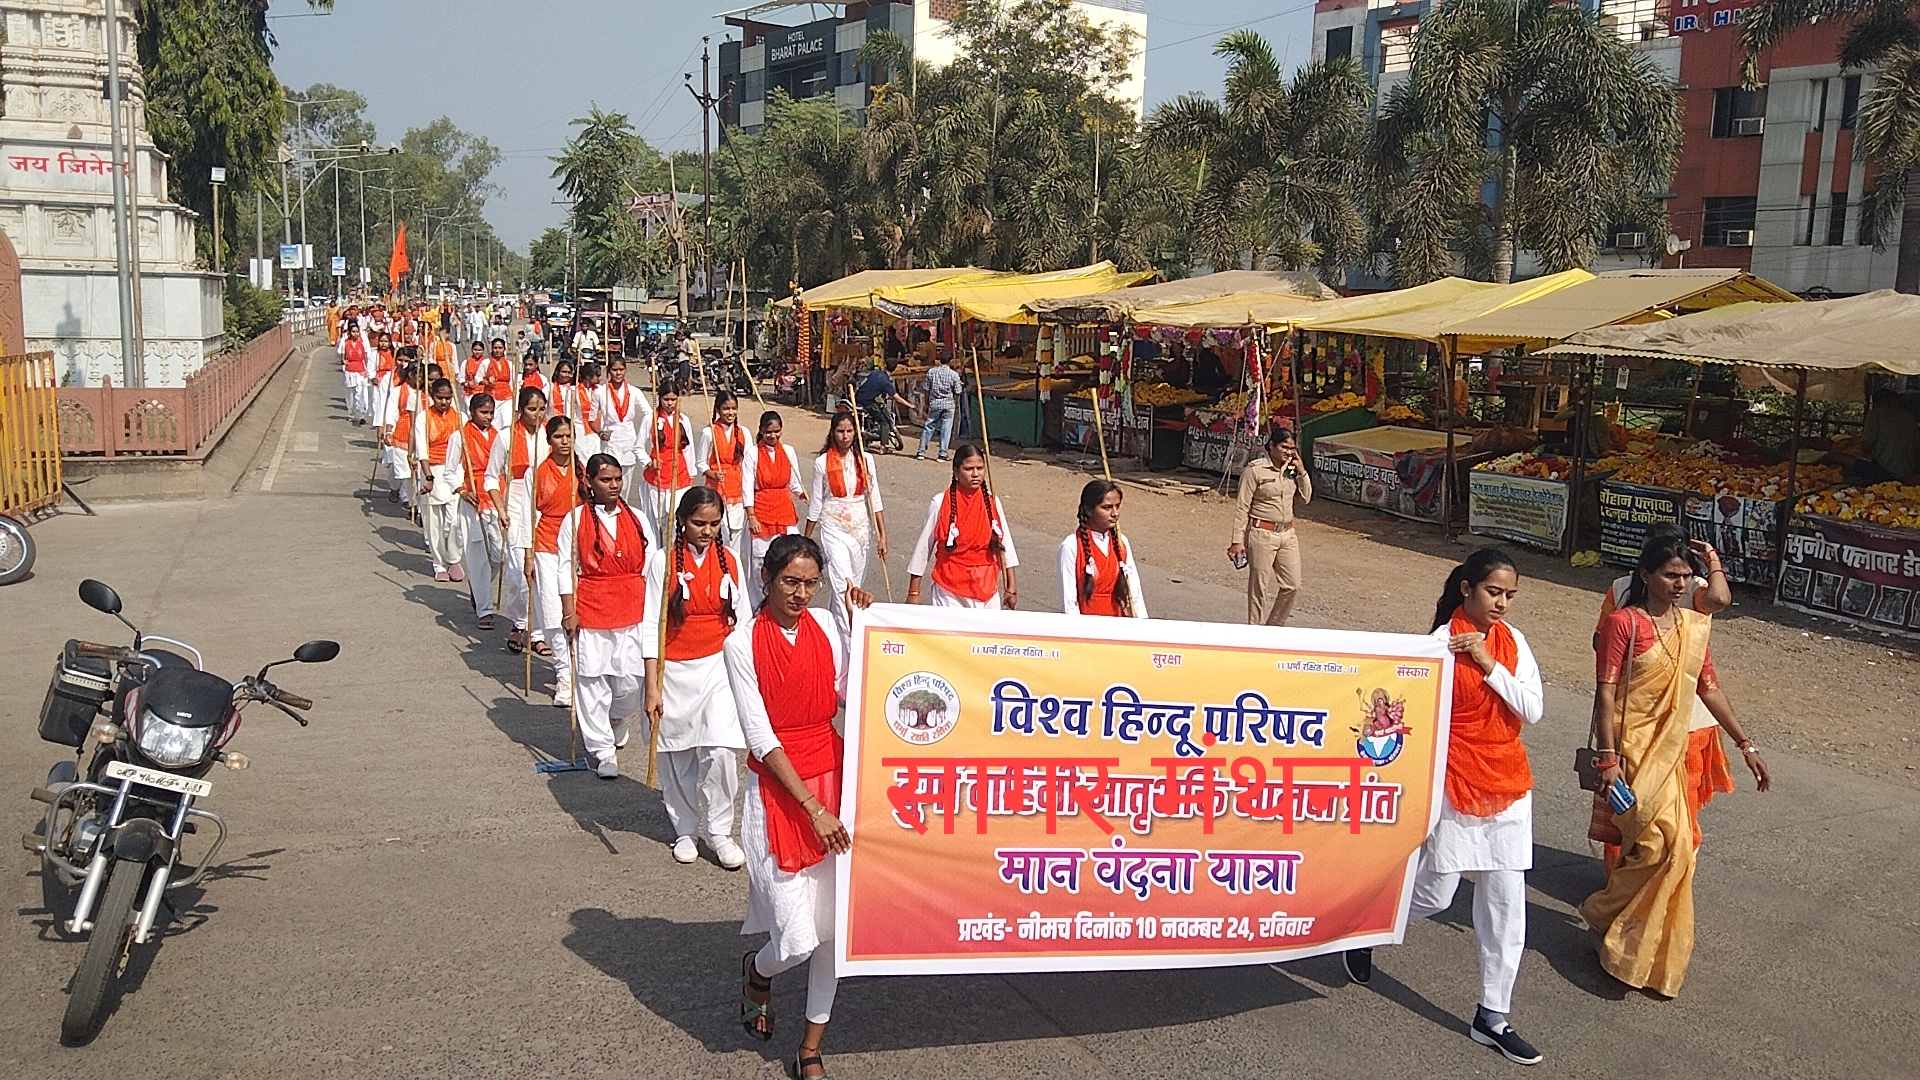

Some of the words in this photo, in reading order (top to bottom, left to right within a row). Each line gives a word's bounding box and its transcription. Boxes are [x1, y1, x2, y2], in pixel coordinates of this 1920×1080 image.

[787, 30, 805, 43] HOTEL
[771, 44, 797, 61] BHARAT
[797, 38, 823, 56] PALACE
[8, 155, 49, 173] जय
[1634, 495, 1674, 514] फ्लावर
[1786, 531, 1840, 564] सुनील
[1842, 544, 1901, 575] फ्लावर
[882, 640, 906, 655] सेवा
[1153, 653, 1182, 668] सुरक्षा
[1396, 663, 1429, 678] संस्कार
[990, 680, 1094, 735] विश्व
[1102, 685, 1204, 758] हिन्दू
[1203, 692, 1327, 747] परिषद
[997, 850, 1085, 891] मान
[1091, 837, 1200, 898] वंदना
[1208, 852, 1302, 892] यात्रा
[957, 912, 1014, 941] प्रखंड-
[1016, 910, 1073, 940] नीमच
[1074, 910, 1134, 940] दिनांक
[1136, 916, 1157, 939] 10
[1159, 917, 1225, 939] नवम्बर
[1226, 916, 1255, 942] 24,
[1258, 911, 1316, 938] रविवार
